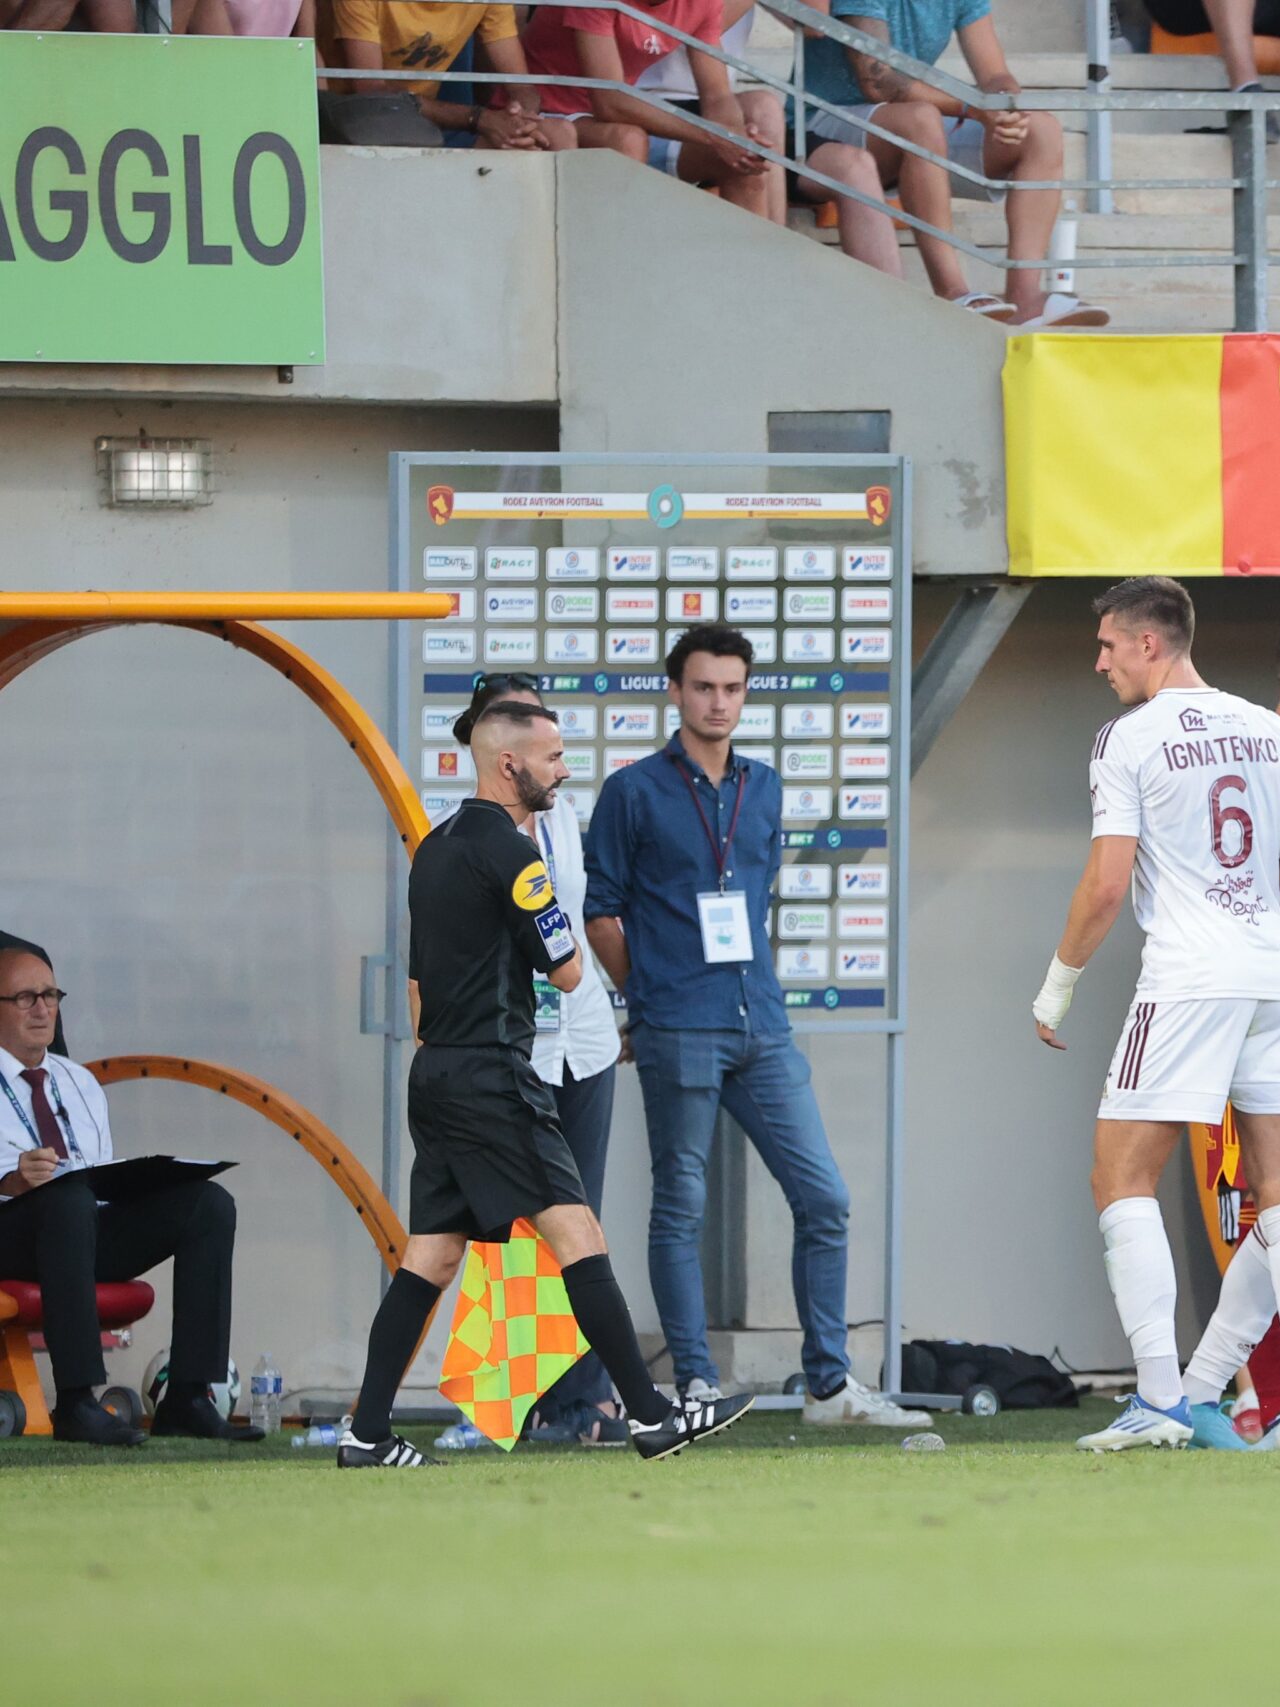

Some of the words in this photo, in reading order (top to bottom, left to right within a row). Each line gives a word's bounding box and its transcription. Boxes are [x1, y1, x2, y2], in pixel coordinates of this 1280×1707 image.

[503, 497, 527, 506] RODEZ
[529, 497, 565, 506] AVEYRON
[566, 497, 603, 506] FOOTBALL
[621, 677, 660, 690] LIGUE
[747, 676, 778, 689] IGUE
[779, 676, 789, 689] 2
[1207, 775, 1253, 869] 6
[541, 912, 560, 930] LFP
